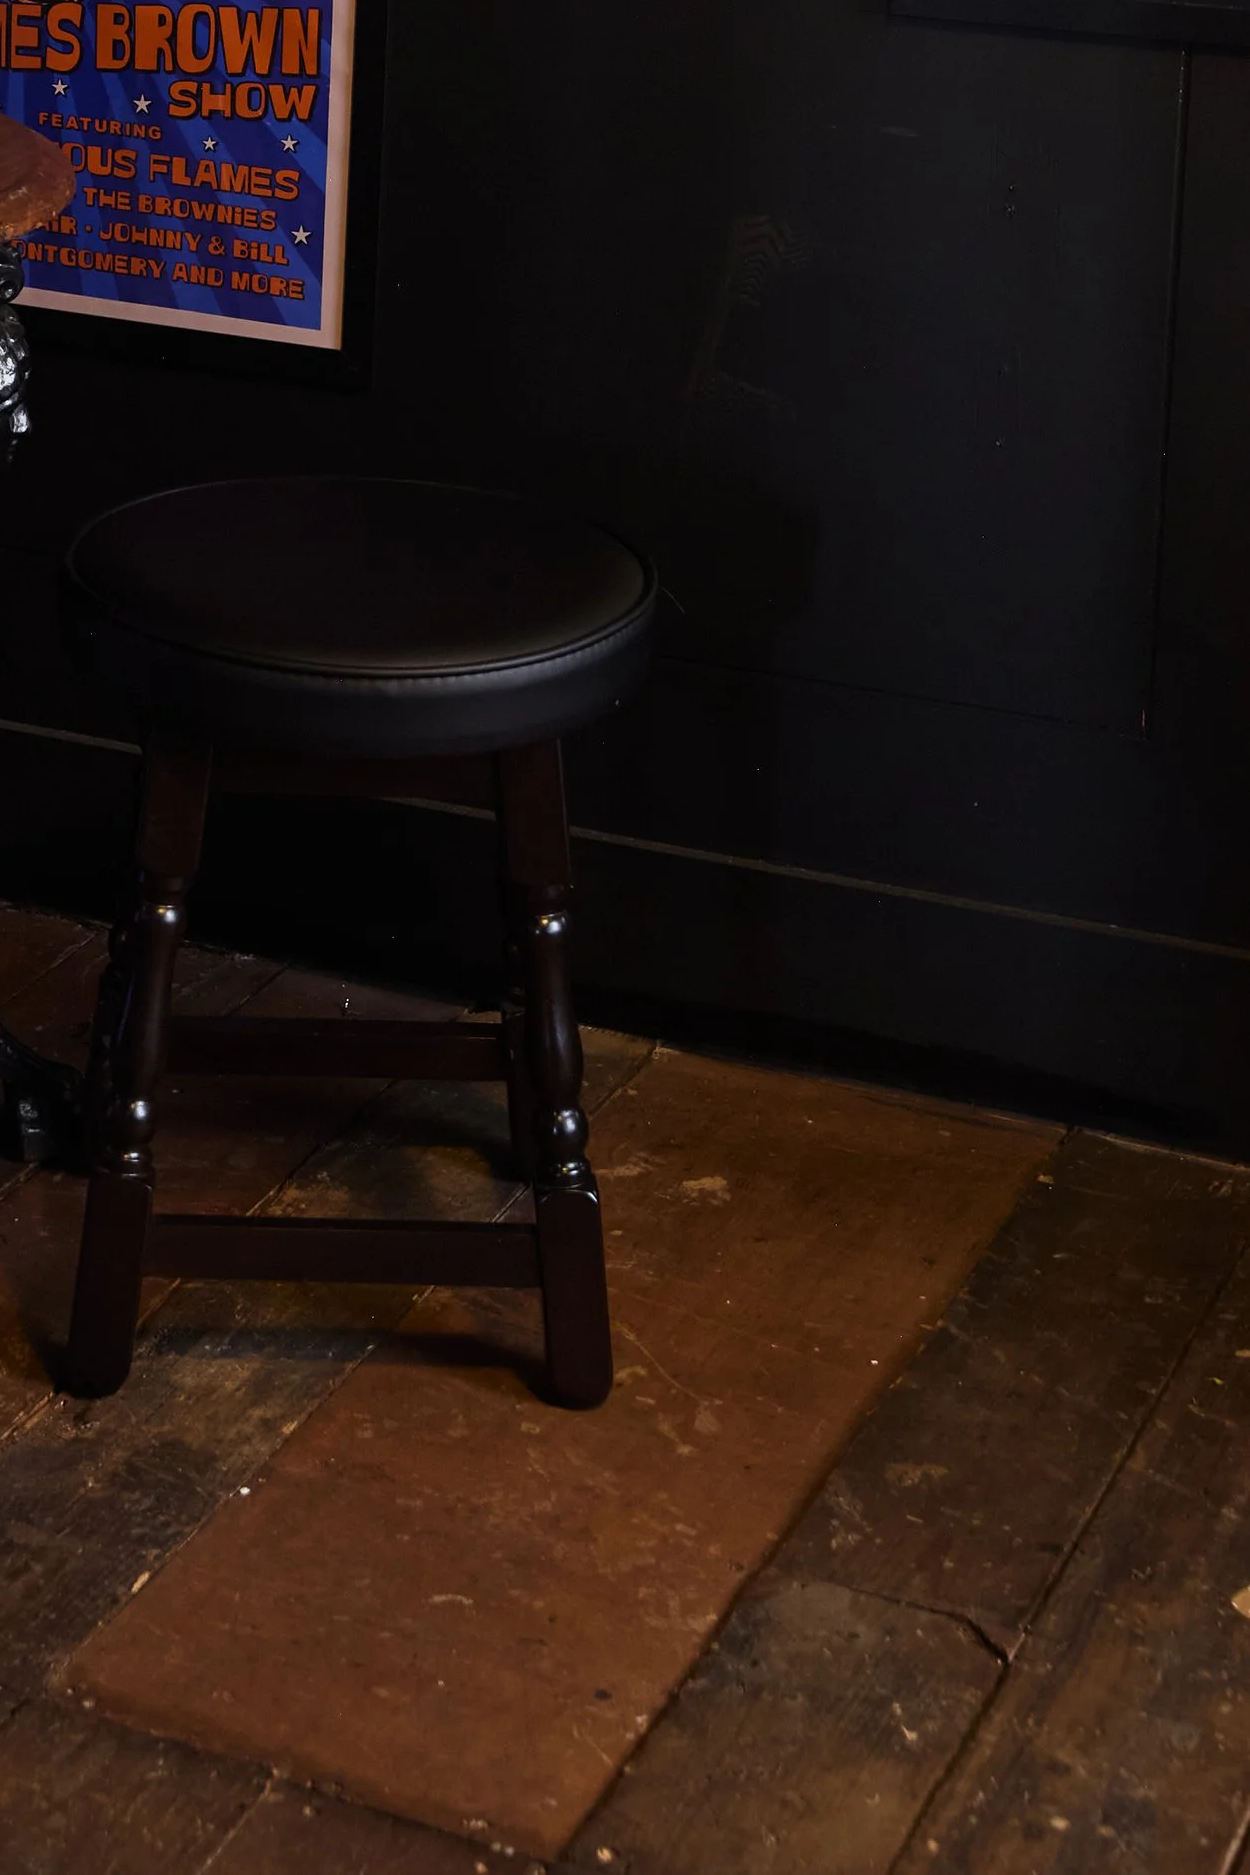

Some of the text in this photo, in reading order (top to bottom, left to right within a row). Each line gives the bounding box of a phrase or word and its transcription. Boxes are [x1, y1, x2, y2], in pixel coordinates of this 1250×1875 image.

[95, 2, 322, 78] BROWN
[168, 79, 318, 123] SHOW
[38, 112, 163, 141] FEATURING
[83, 186, 132, 210] THE
[149, 154, 302, 202] FLAMES
[99, 222, 202, 257] JOHNNY
[206, 235, 227, 257] &
[11, 239, 306, 301] ONTGOMERY AND MORE
